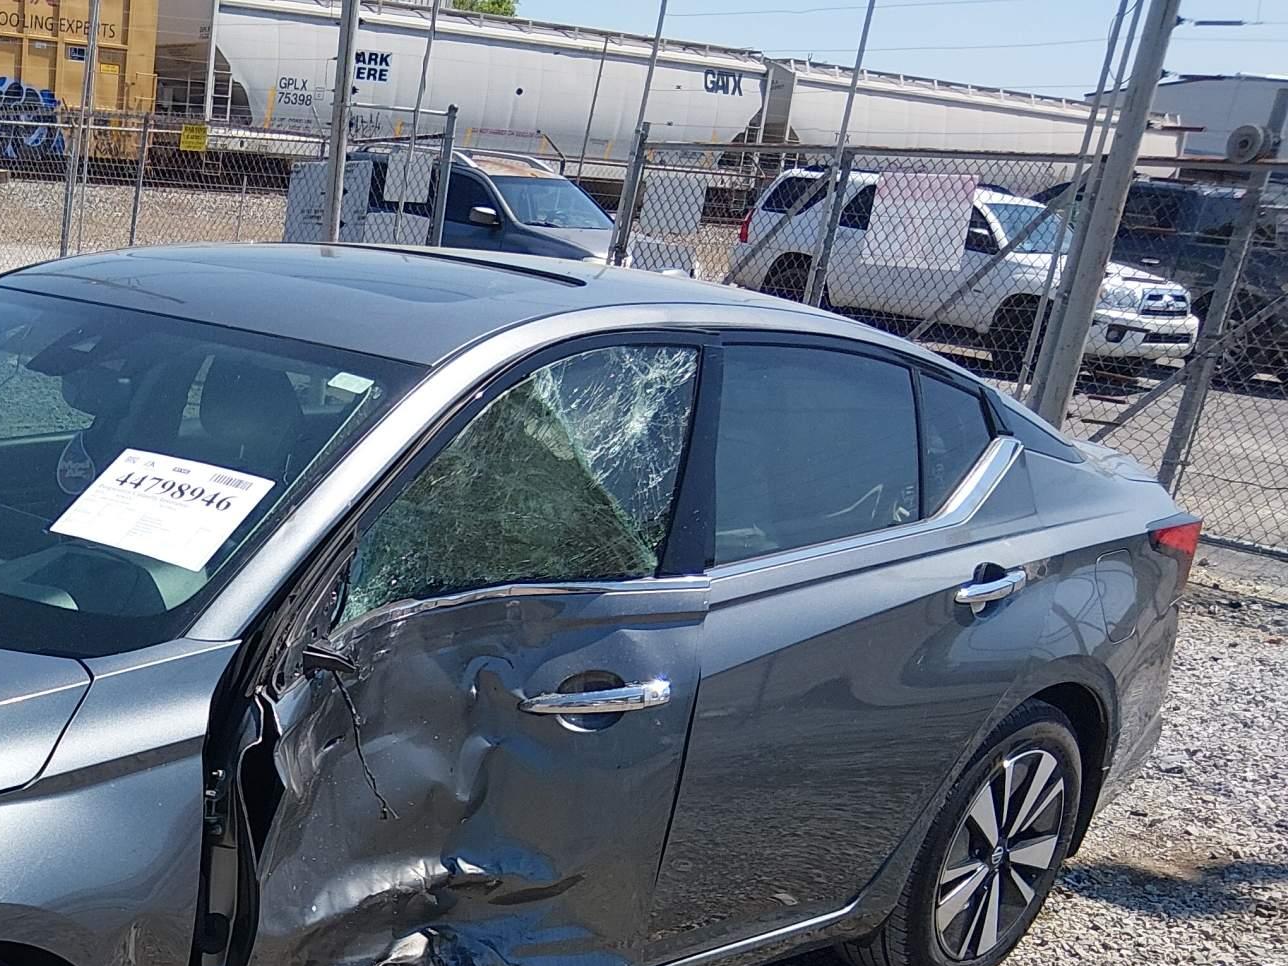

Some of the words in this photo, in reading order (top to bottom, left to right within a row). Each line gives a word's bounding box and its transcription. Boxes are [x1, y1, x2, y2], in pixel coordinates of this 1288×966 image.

[59, 17, 116, 39] EXPETS
[354, 51, 391, 66] ARK
[355, 66, 389, 82] ERE
[279, 77, 309, 92] GPLX
[703, 69, 743, 96] GATX
[277, 92, 313, 107] 75398
[115, 471, 239, 512] 44798946
